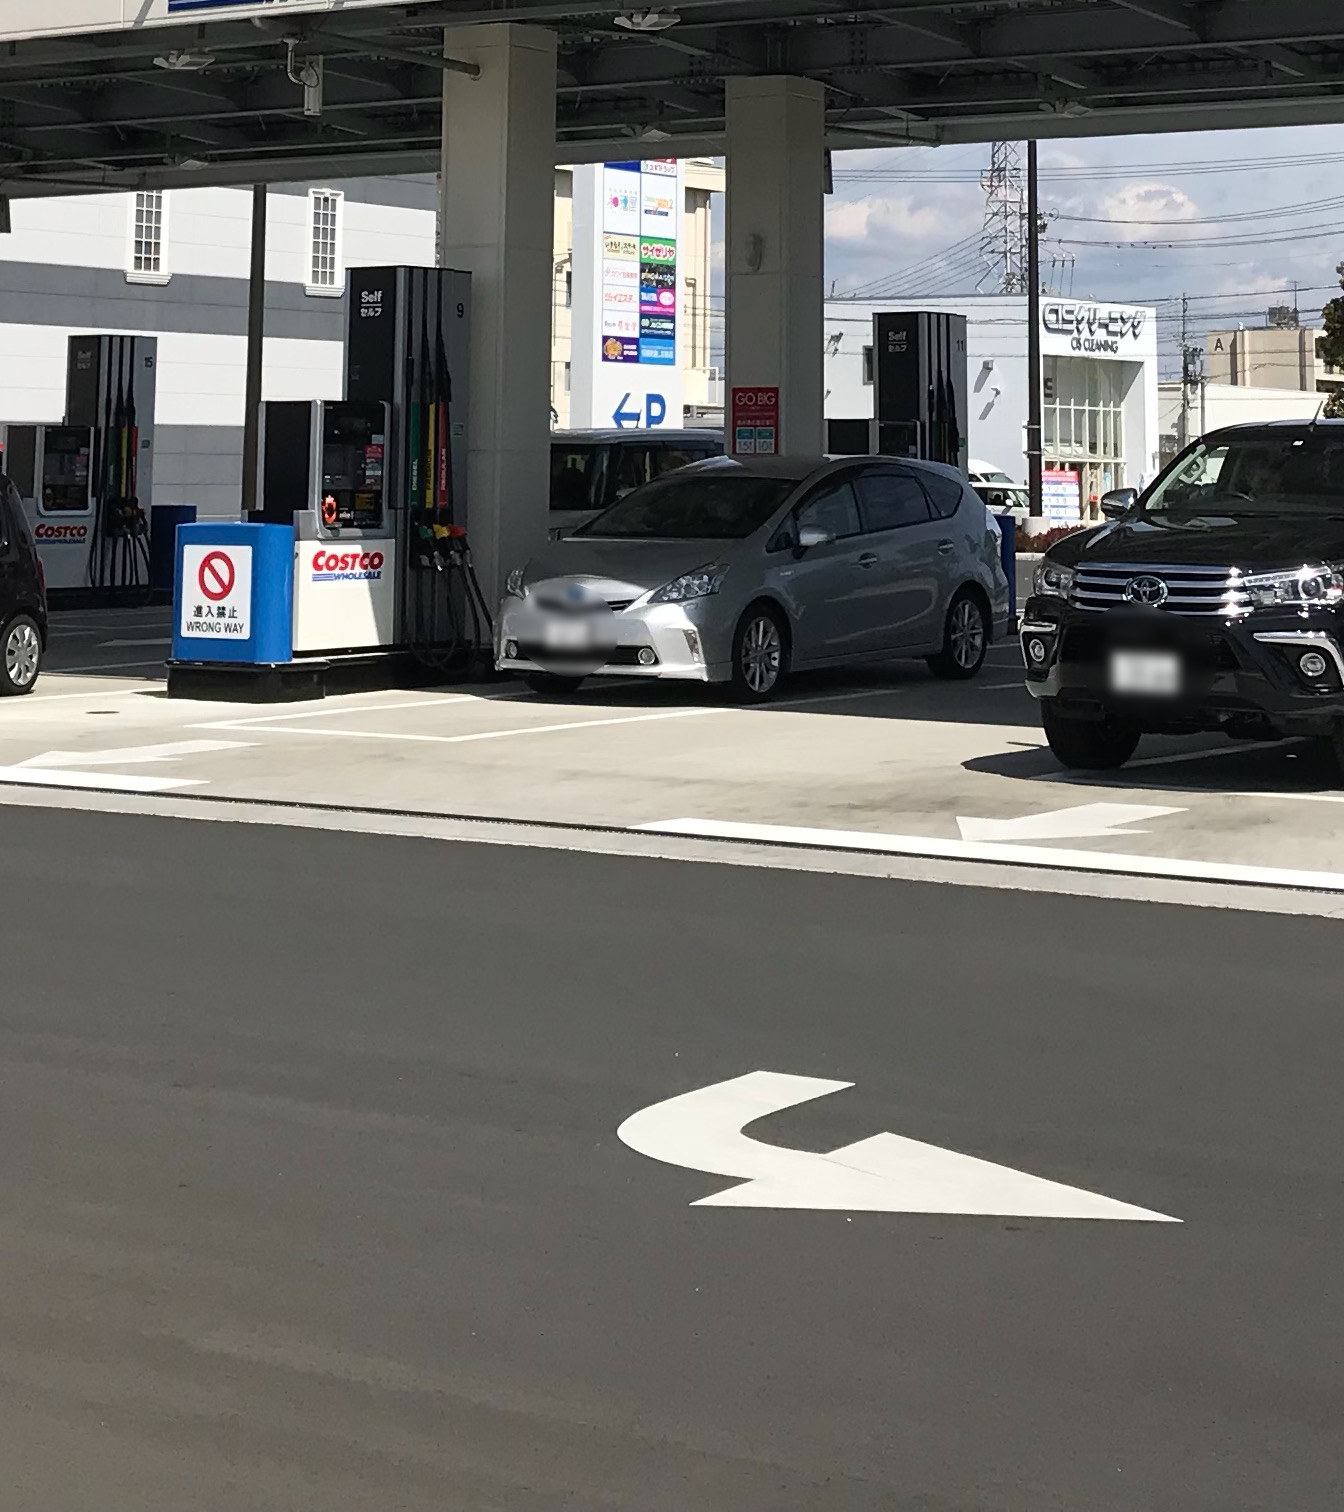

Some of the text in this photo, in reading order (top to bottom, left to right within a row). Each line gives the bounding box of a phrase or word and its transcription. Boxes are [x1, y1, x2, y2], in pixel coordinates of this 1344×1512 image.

[642, 245, 674, 258] サイゼリヤ
[361, 291, 382, 303] Self
[360, 308, 382, 317] セルフ
[456, 303, 464, 319] 9
[1083, 338, 1118, 354] CLEANING
[144, 357, 153, 368] 15
[736, 392, 756, 405] GO
[646, 393, 666, 428] P
[35, 524, 88, 538] COSTCO
[312, 550, 384, 571] COSTCO
[333, 571, 382, 581] WHOLESALE
[193, 605, 238, 619] 進入禁止
[186, 621, 244, 634] WRONG WAY
